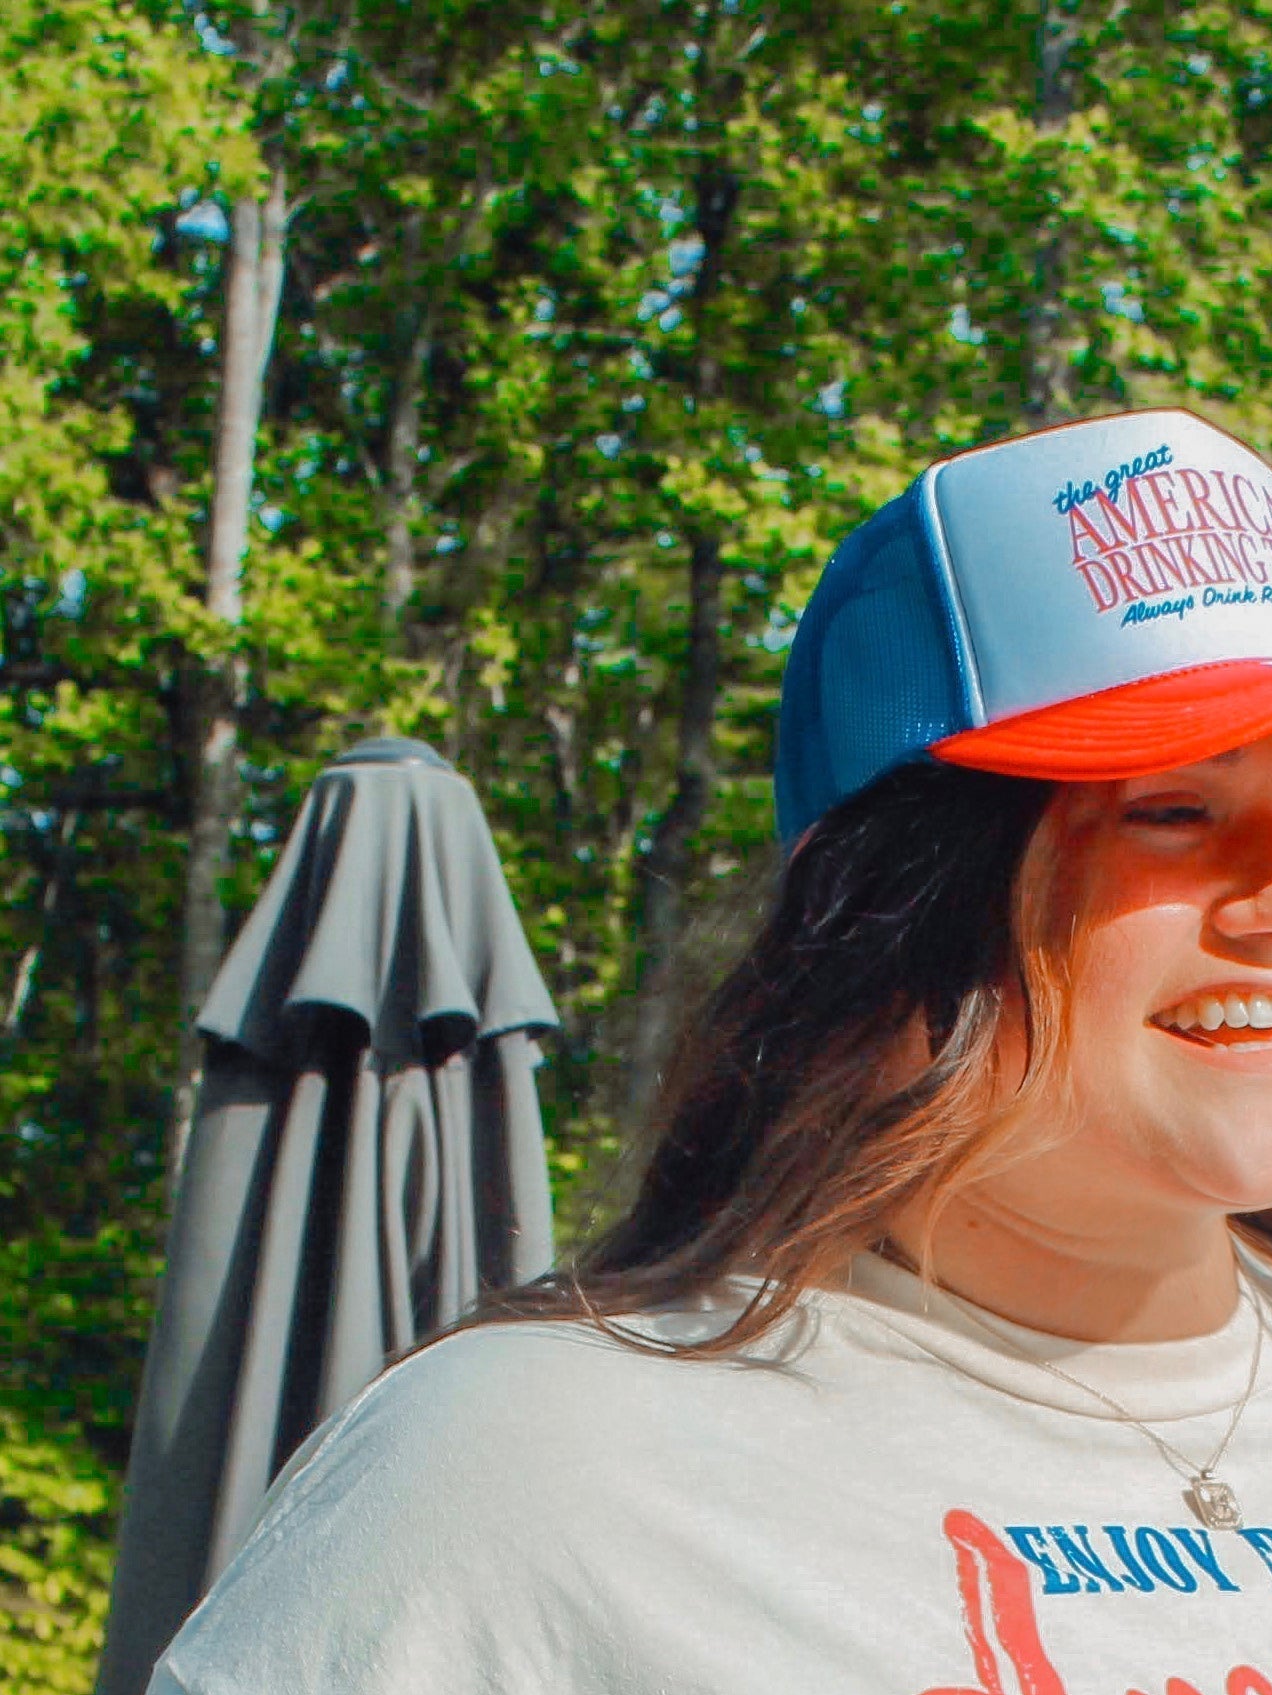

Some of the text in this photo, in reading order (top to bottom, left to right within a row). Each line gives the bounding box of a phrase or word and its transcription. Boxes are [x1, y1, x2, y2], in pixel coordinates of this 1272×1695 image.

[1053, 444, 1173, 515] the great
[1077, 533, 1268, 614] DRINKING
[1120, 594, 1195, 629] Always
[1202, 585, 1257, 607] Drink
[1004, 1524, 1241, 1597] ENJOY
